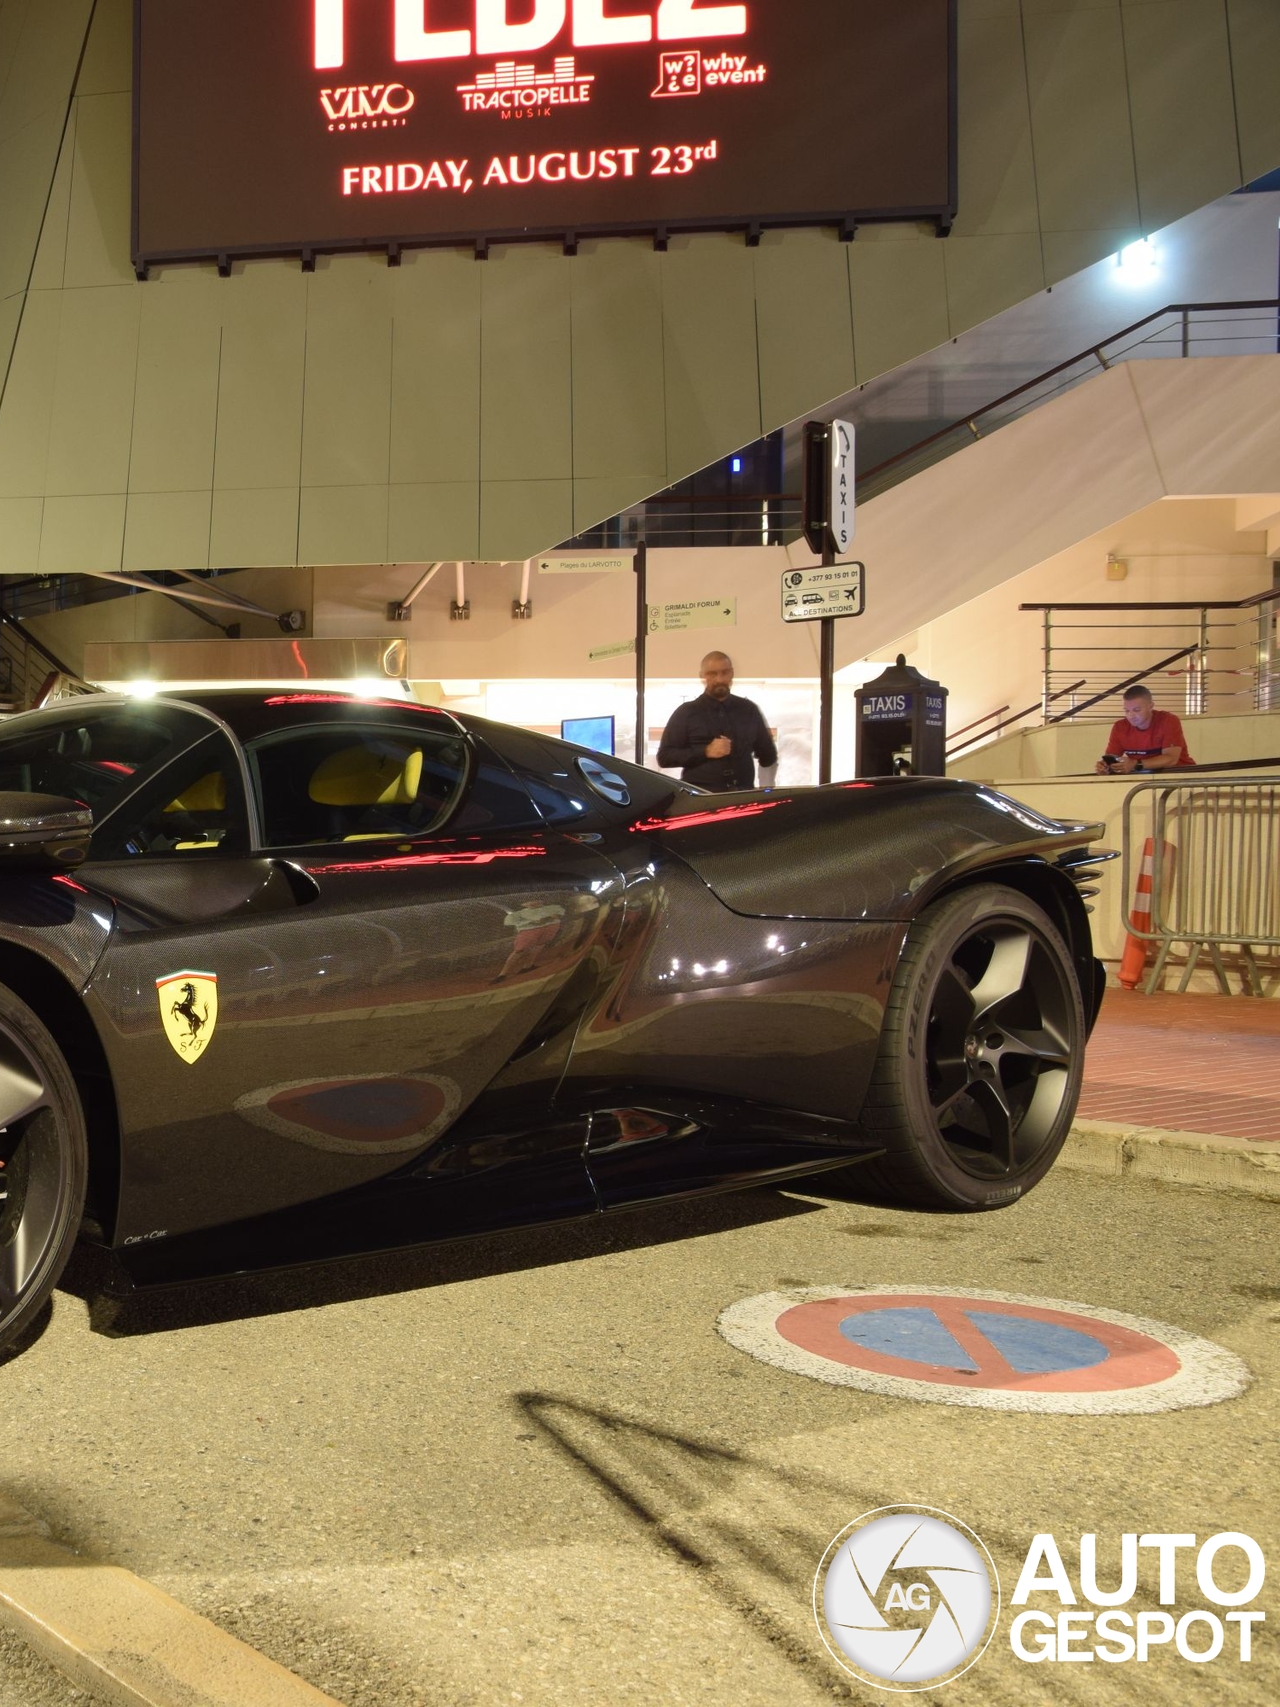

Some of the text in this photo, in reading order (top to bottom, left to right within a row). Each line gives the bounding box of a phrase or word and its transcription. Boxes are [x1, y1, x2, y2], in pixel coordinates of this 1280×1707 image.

[703, 52, 747, 71] why
[705, 65, 766, 86] event
[320, 83, 415, 119] VIVO
[462, 84, 590, 111] TRACTOPELLE
[501, 107, 551, 120] MUSIK
[342, 139, 718, 195] FRIDAY, AUGUST 23rd
[839, 454, 848, 544] TAXIS
[560, 562, 579, 570] Plages
[588, 560, 622, 568] LARVOTTO
[808, 574, 824, 582] +377
[664, 600, 721, 611] GRIMALDI FORUM
[803, 604, 853, 616] DESTINATIONS
[869, 695, 906, 712] TAXIS
[925, 696, 942, 709] TAXIS
